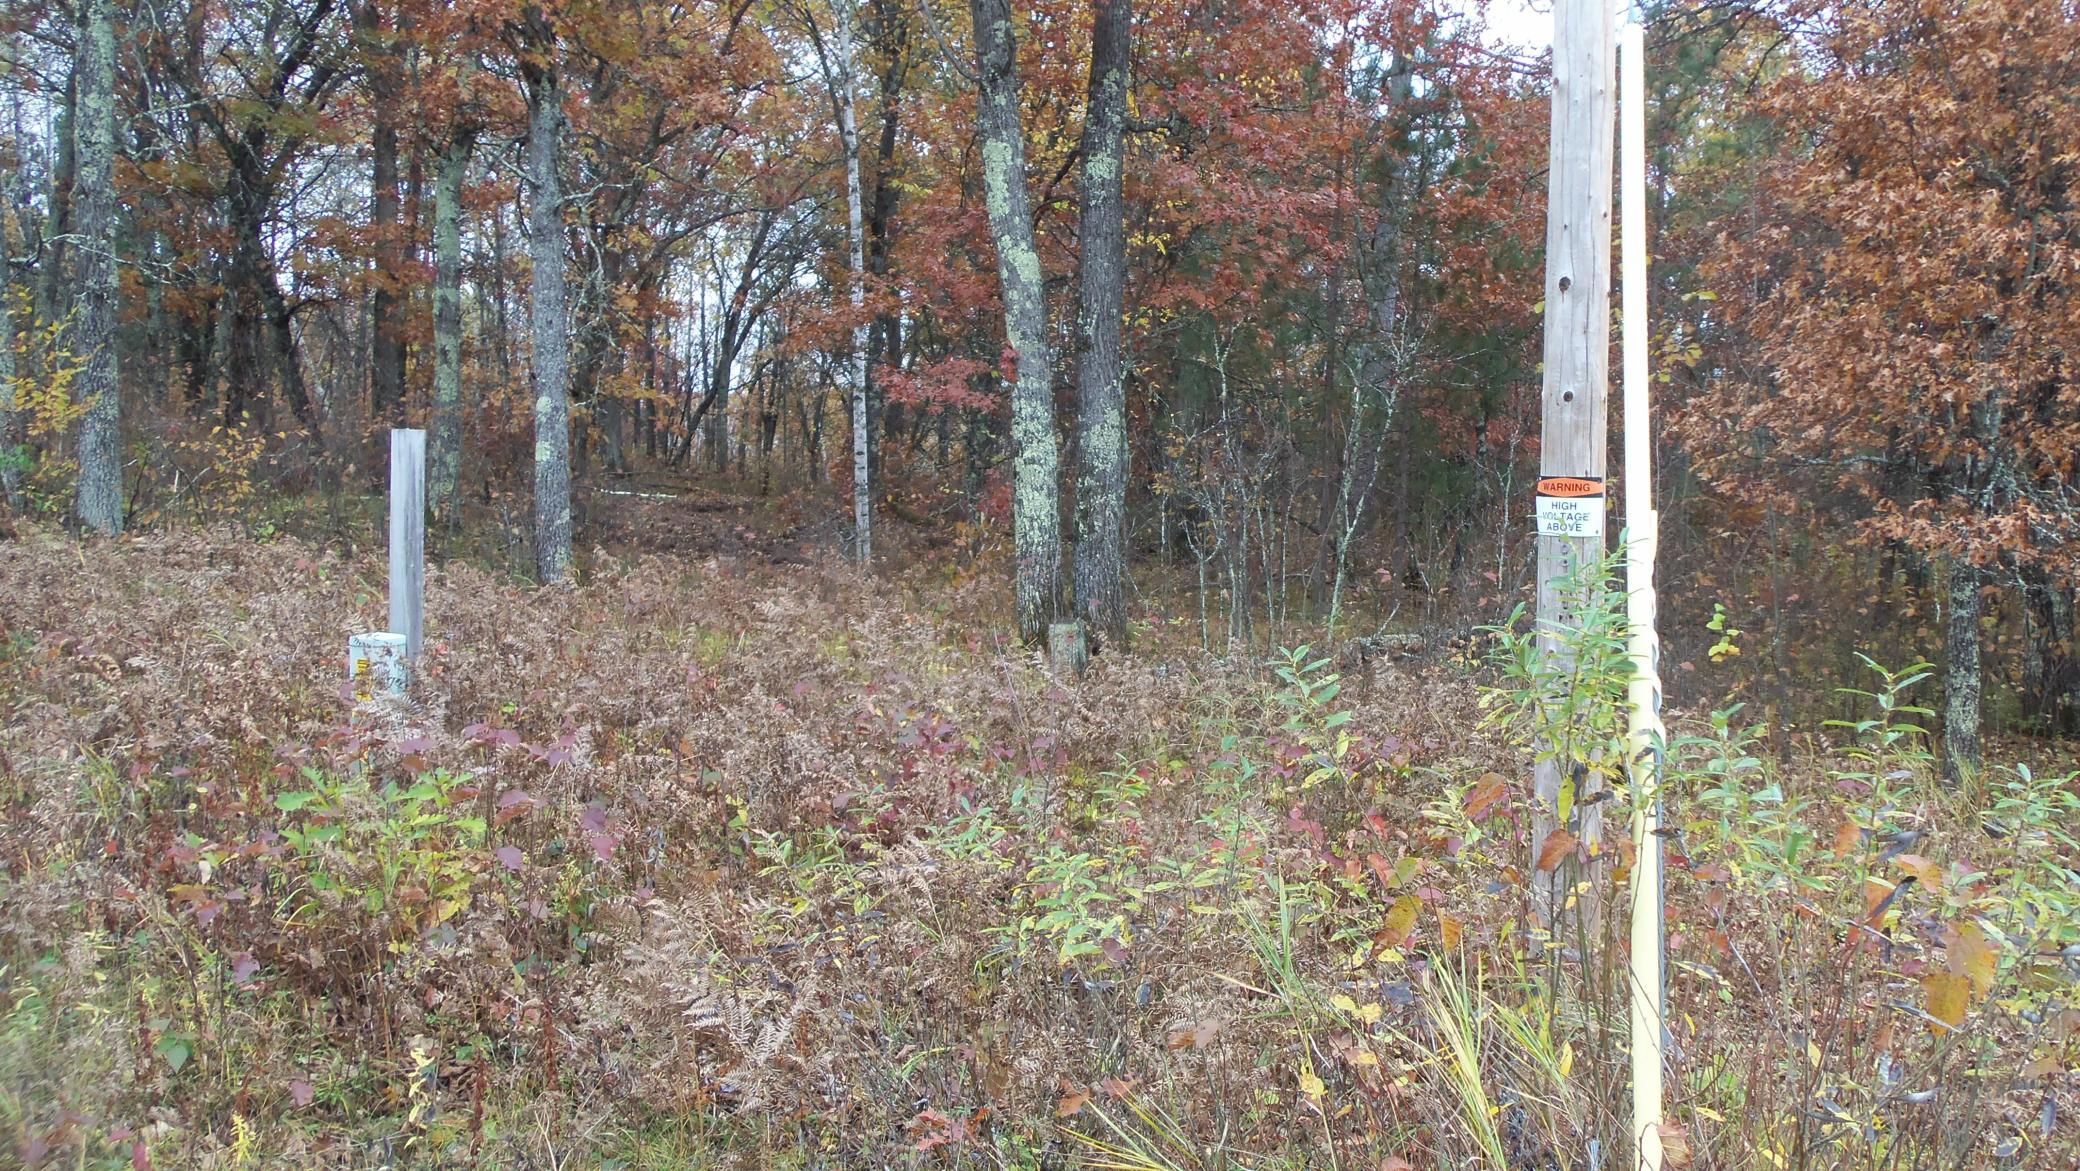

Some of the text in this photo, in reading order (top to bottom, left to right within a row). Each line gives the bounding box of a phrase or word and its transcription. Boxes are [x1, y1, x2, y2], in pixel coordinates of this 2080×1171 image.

[1543, 482, 1590, 492] WARNING
[1551, 501, 1577, 510] HIGH
[1542, 512, 1590, 521] VOLTAGE
[1546, 522, 1582, 531] ABOVE
